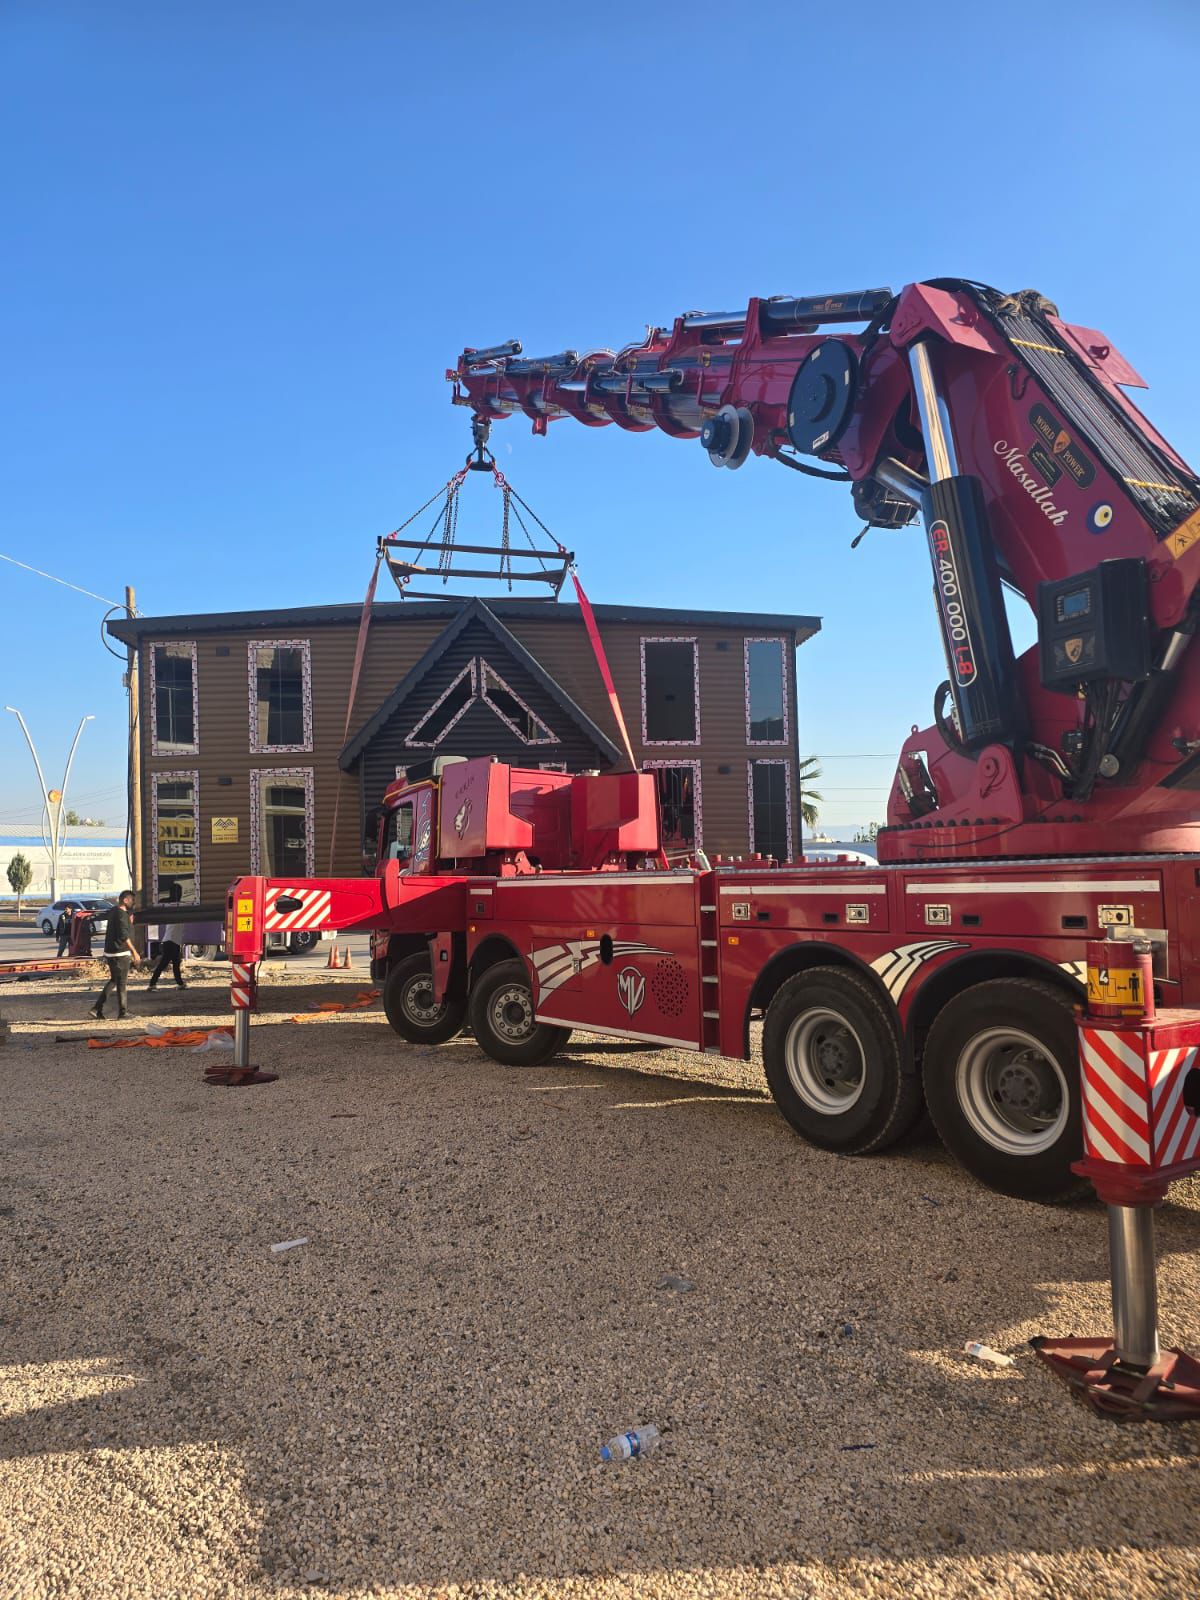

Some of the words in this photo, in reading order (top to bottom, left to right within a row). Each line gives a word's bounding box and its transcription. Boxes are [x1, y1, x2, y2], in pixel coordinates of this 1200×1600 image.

[1036, 415, 1055, 440] WORLD
[1063, 450, 1085, 477] POWER
[947, 602, 966, 641] 000
[1099, 970, 1109, 983] 4
